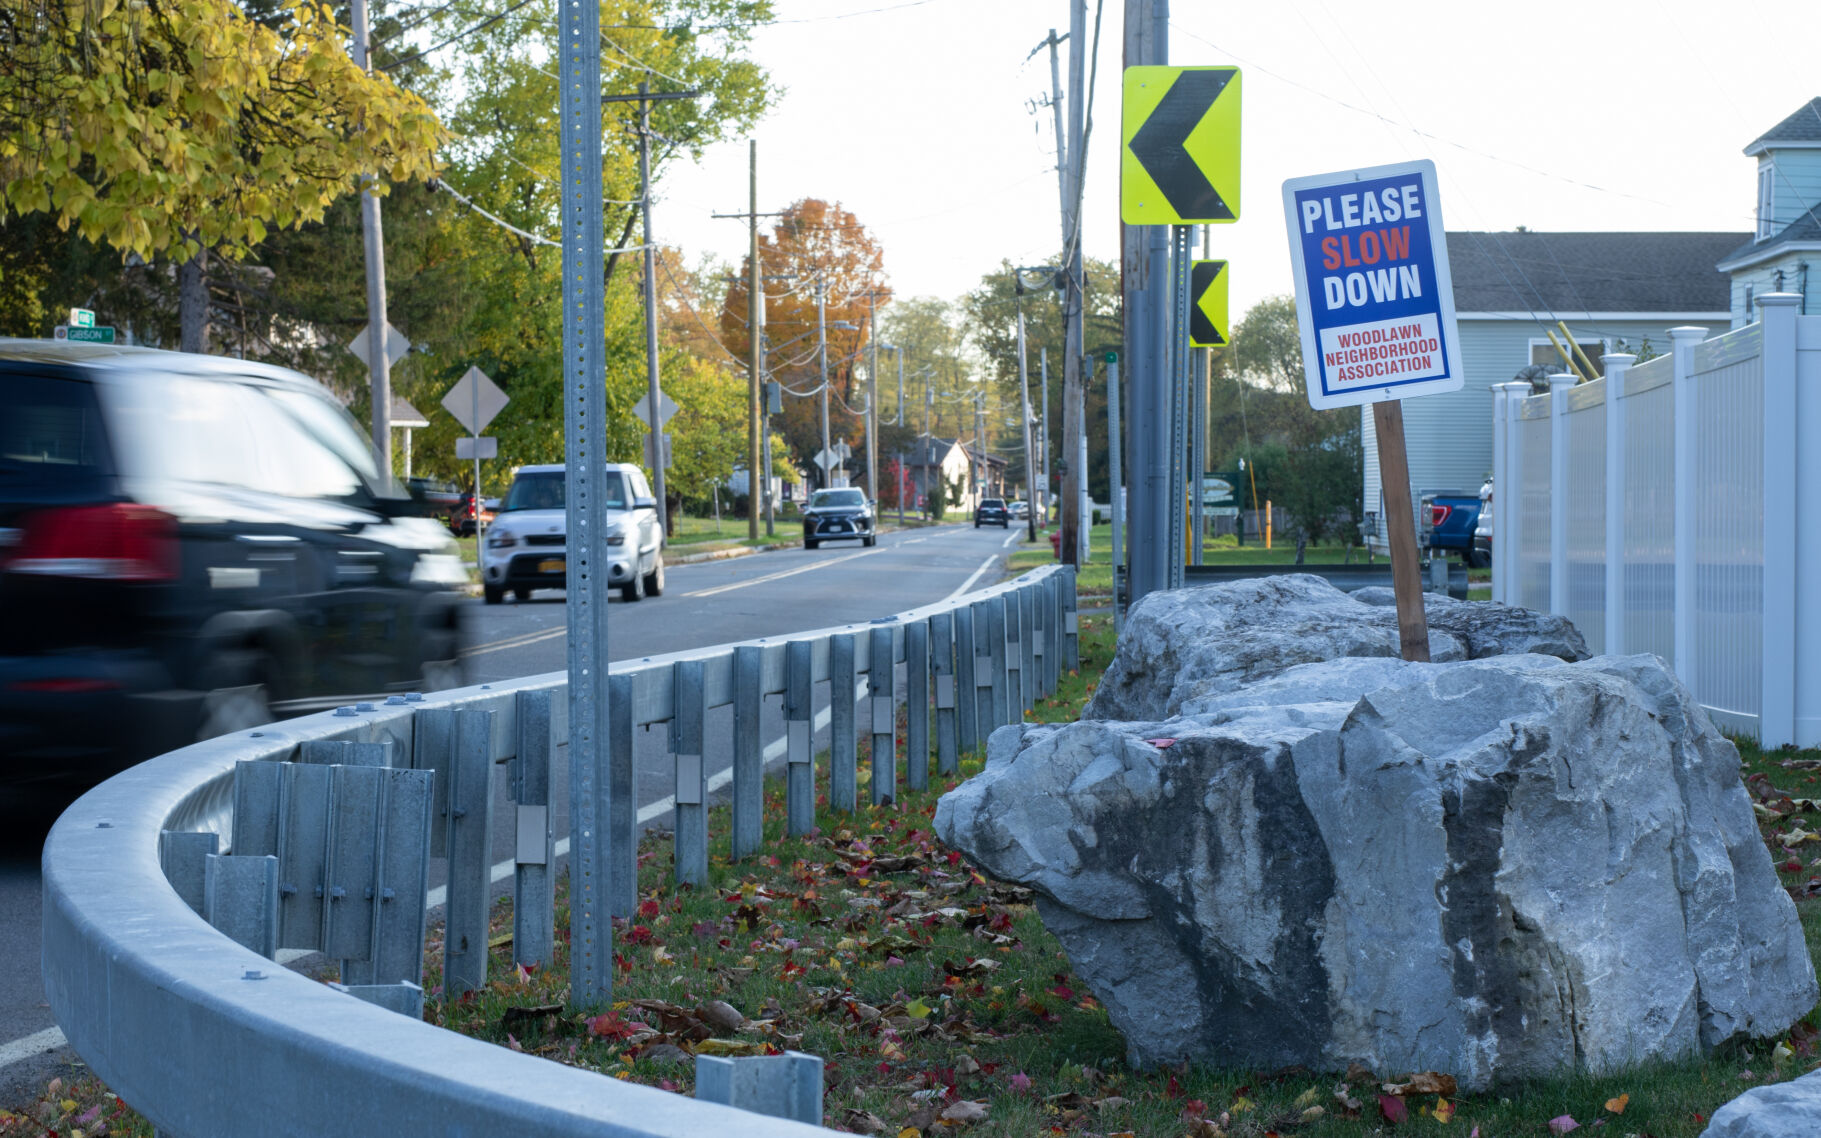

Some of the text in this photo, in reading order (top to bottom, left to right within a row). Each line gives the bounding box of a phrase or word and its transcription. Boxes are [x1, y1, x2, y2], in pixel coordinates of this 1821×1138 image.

[1302, 184, 1422, 234] PLEASE
[1321, 226, 1410, 270] SLOW
[1323, 264, 1422, 310] DOWN
[70, 330, 102, 340] GIBSON
[1338, 323, 1422, 348] WOODLAWN
[1326, 338, 1438, 367] NEIGHBORHOOD
[1338, 355, 1432, 382] ASSOCIATION
